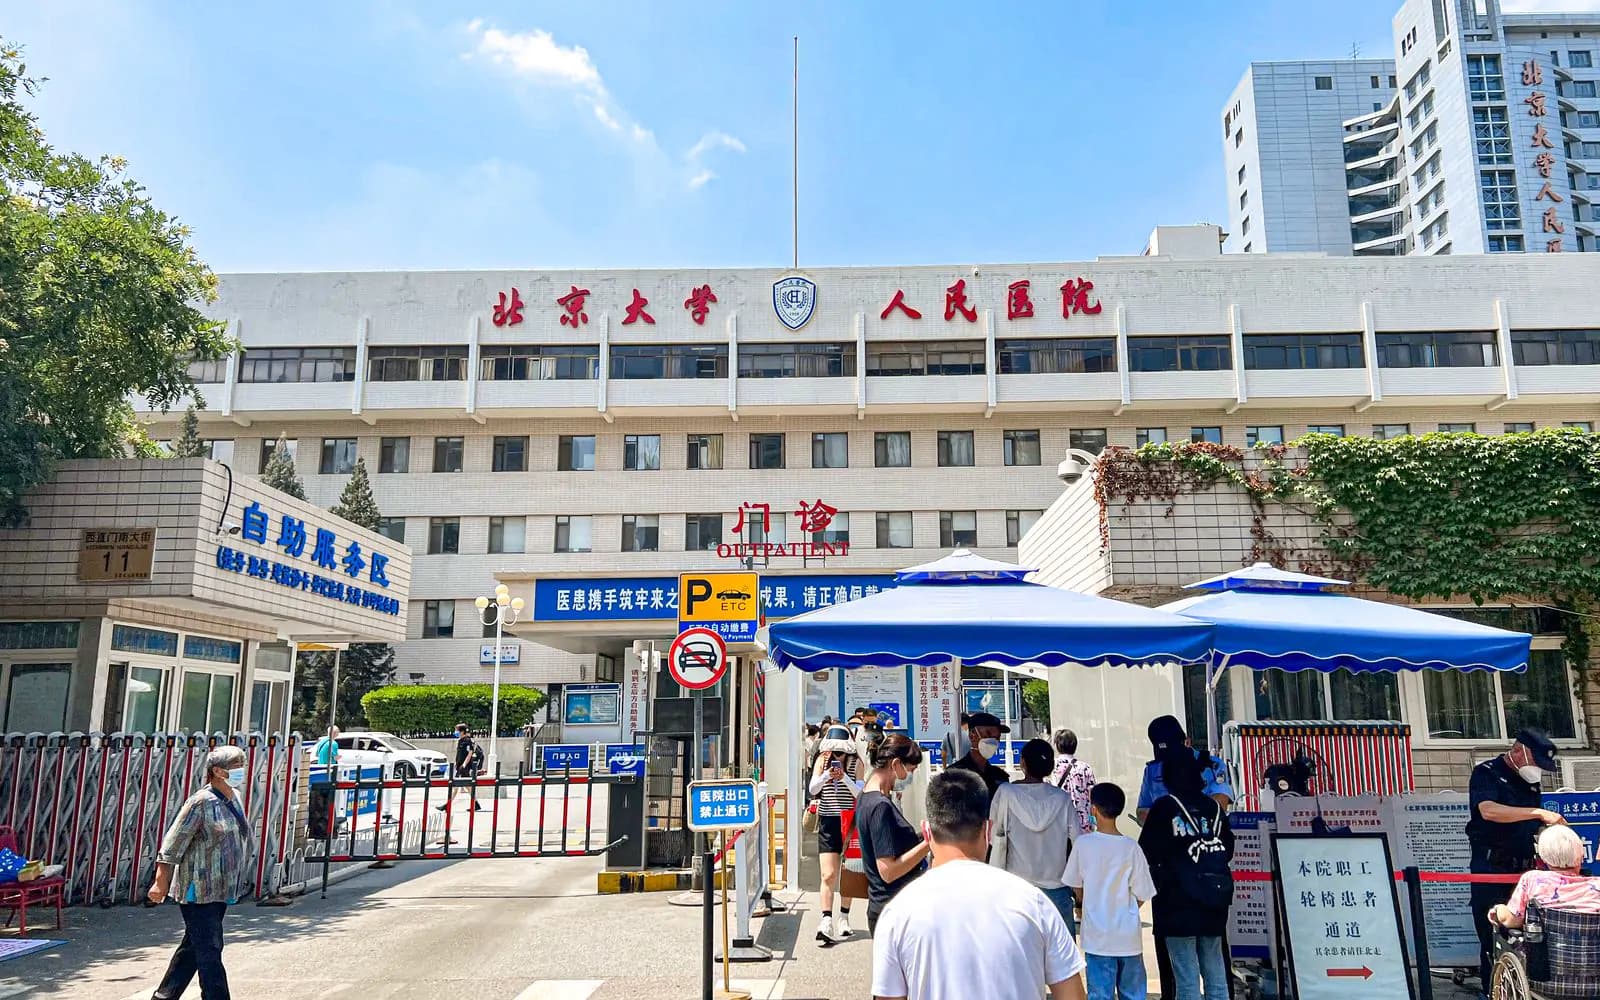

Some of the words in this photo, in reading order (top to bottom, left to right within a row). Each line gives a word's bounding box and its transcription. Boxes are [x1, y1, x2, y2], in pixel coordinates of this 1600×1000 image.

[492, 284, 717, 329] 北京大学
[880, 277, 1102, 323] 人民医院
[732, 499, 838, 534] 门诊
[242, 501, 391, 588] 自助服务区
[717, 542, 849, 558] OUTPATIENT
[103, 551, 128, 572] 11
[687, 579, 713, 616] P
[721, 602, 747, 611] ETC
[700, 789, 748, 802] 医院出口
[700, 804, 750, 818] 禁止通行
[1563, 801, 1599, 812] 北京大学
[1298, 860, 1372, 877] 本院职工
[1300, 890, 1377, 908] 轮椅患者
[1325, 921, 1361, 938] 通道
